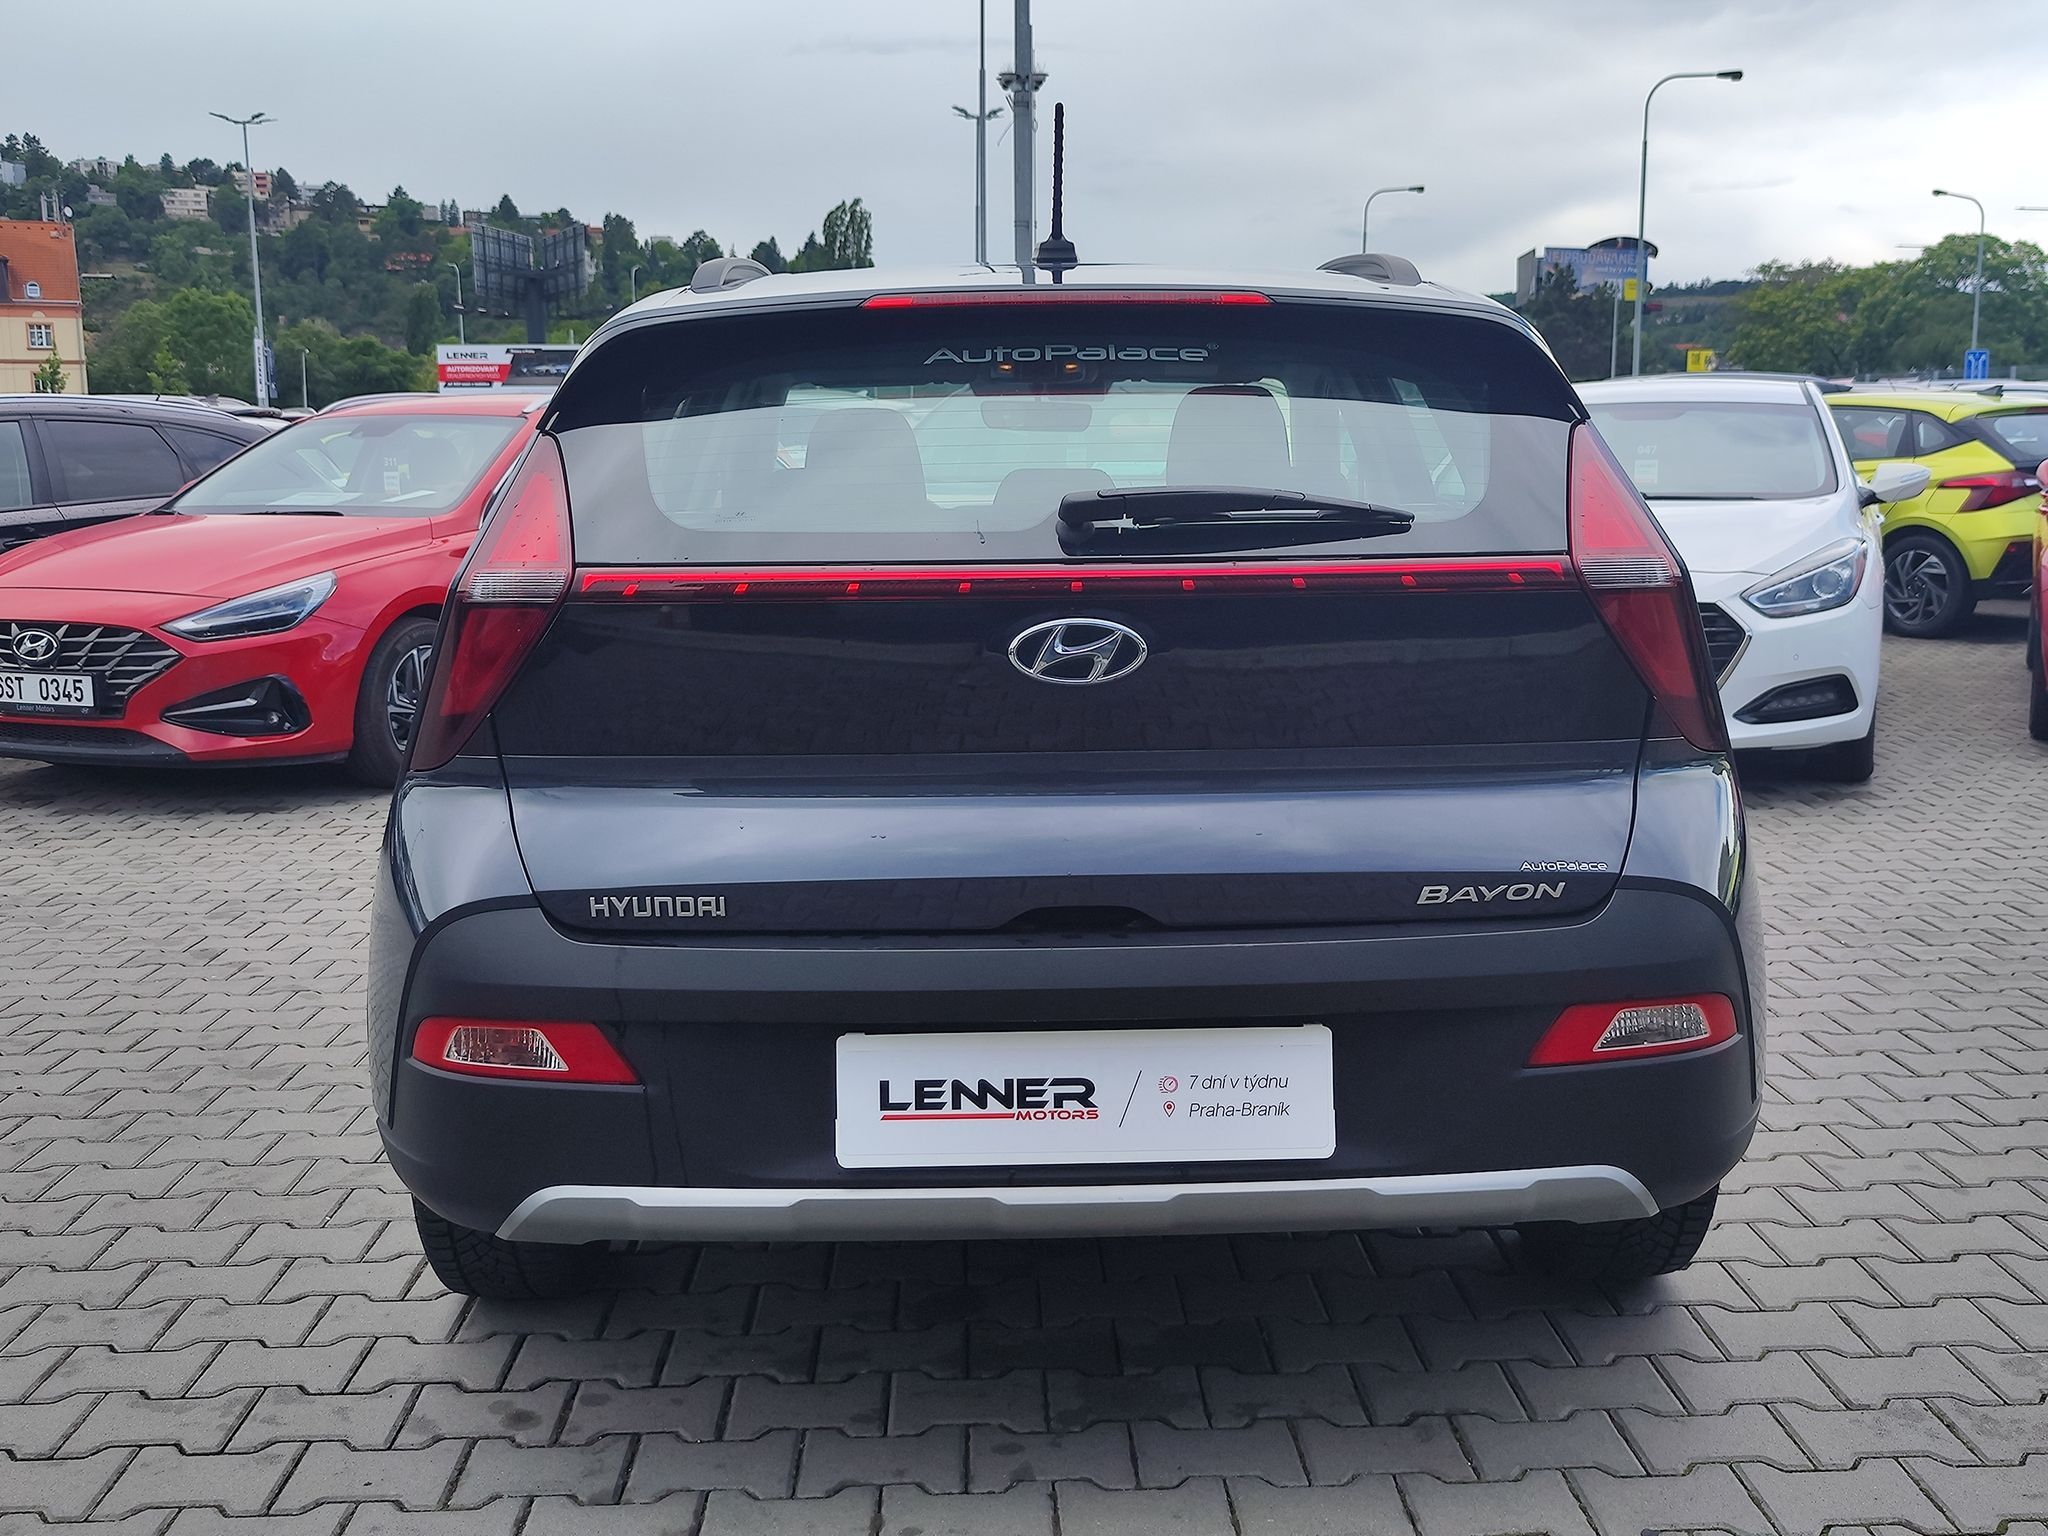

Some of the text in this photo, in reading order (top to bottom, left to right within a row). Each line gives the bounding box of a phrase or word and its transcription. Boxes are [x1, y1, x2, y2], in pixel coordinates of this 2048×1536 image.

[446, 352, 489, 360] LENNER
[923, 344, 1210, 365] AutoPalace
[39, 678, 84, 702] 0345
[35, 705, 55, 713] Motors
[1520, 860, 1608, 872] AutoPalace
[1416, 881, 1566, 905] BAYON
[589, 896, 726, 918] HYUNDAI
[1189, 1074, 1289, 1093] 7 dní v týdnu
[879, 1077, 1099, 1112] LENNER
[1015, 1109, 1100, 1121] MOTORS
[1188, 1101, 1291, 1118] Praha-Braník
